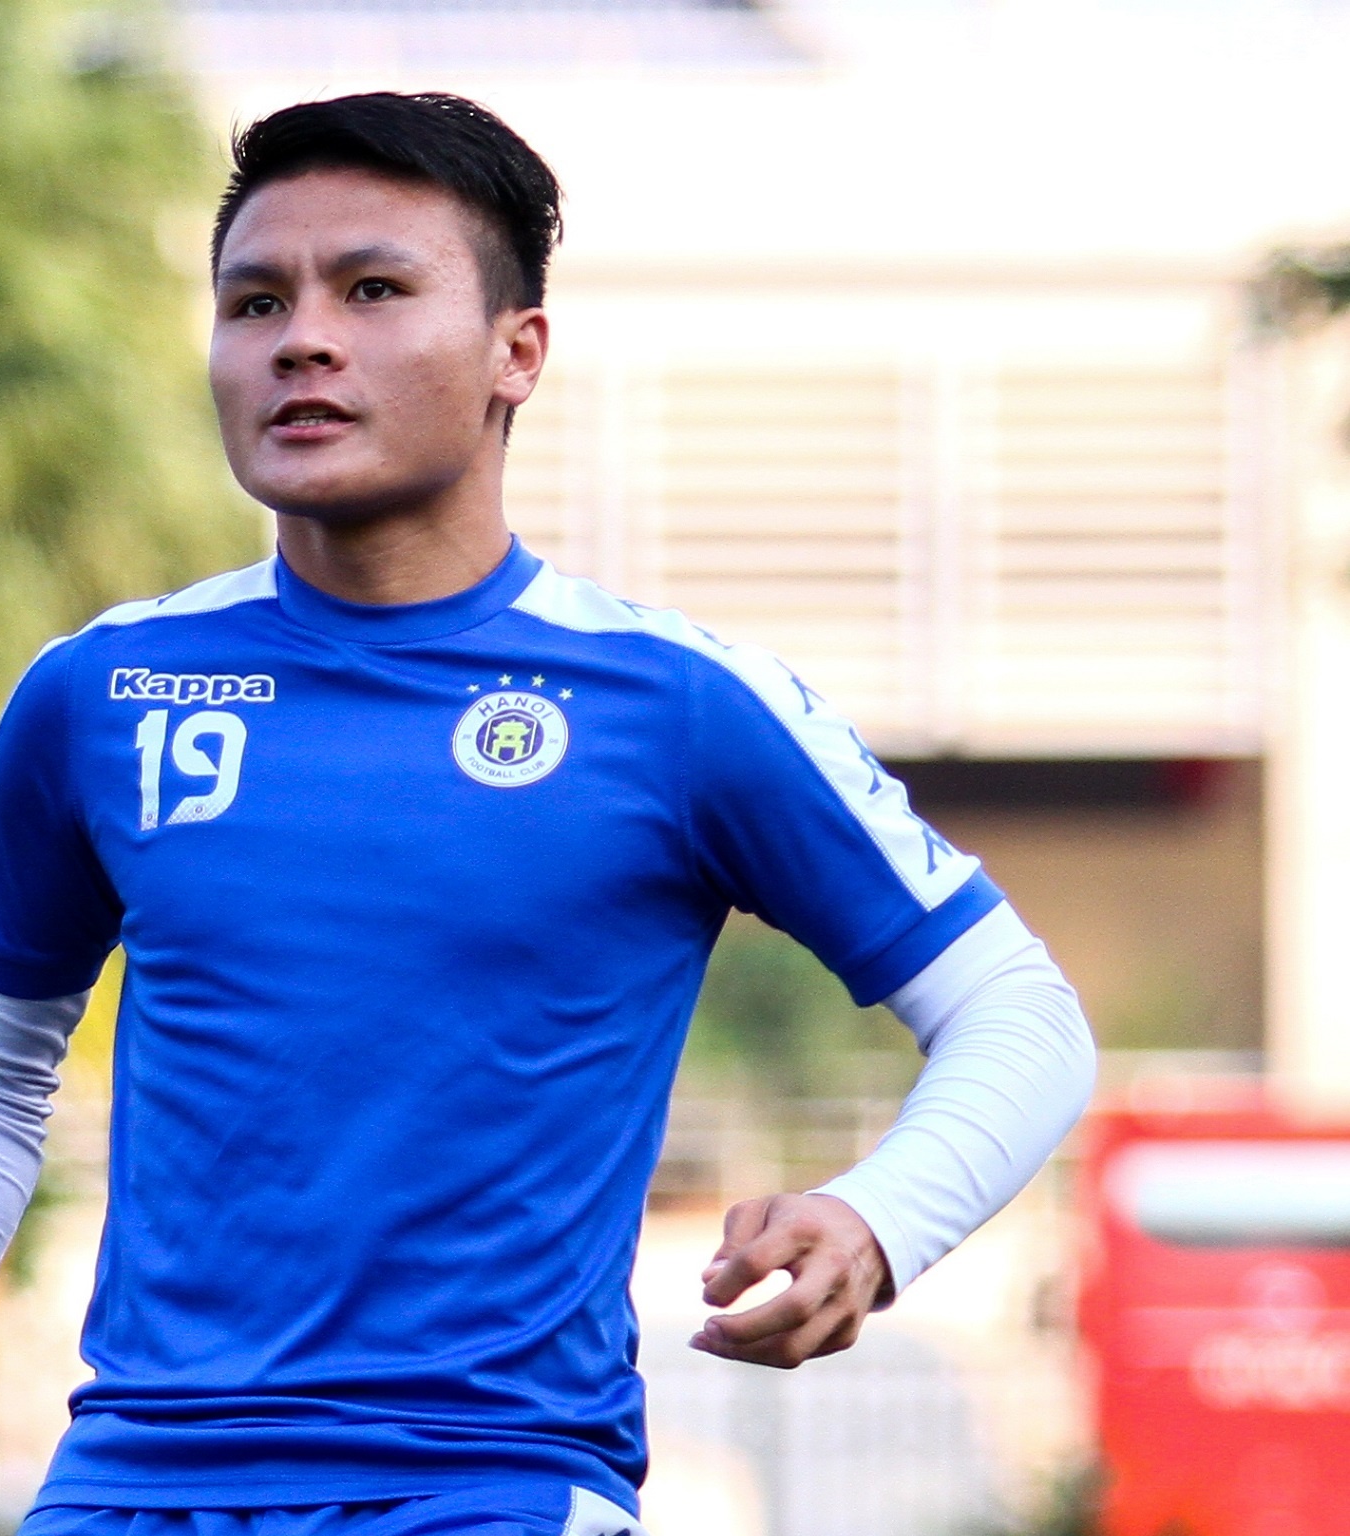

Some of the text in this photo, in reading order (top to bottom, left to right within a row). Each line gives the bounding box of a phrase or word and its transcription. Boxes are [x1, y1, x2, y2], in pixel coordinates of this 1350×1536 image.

[110, 668, 275, 704] Kappa
[477, 696, 554, 717] HANOI
[135, 709, 247, 831] 19
[466, 756, 546, 778] FOOTBALL CLUB
